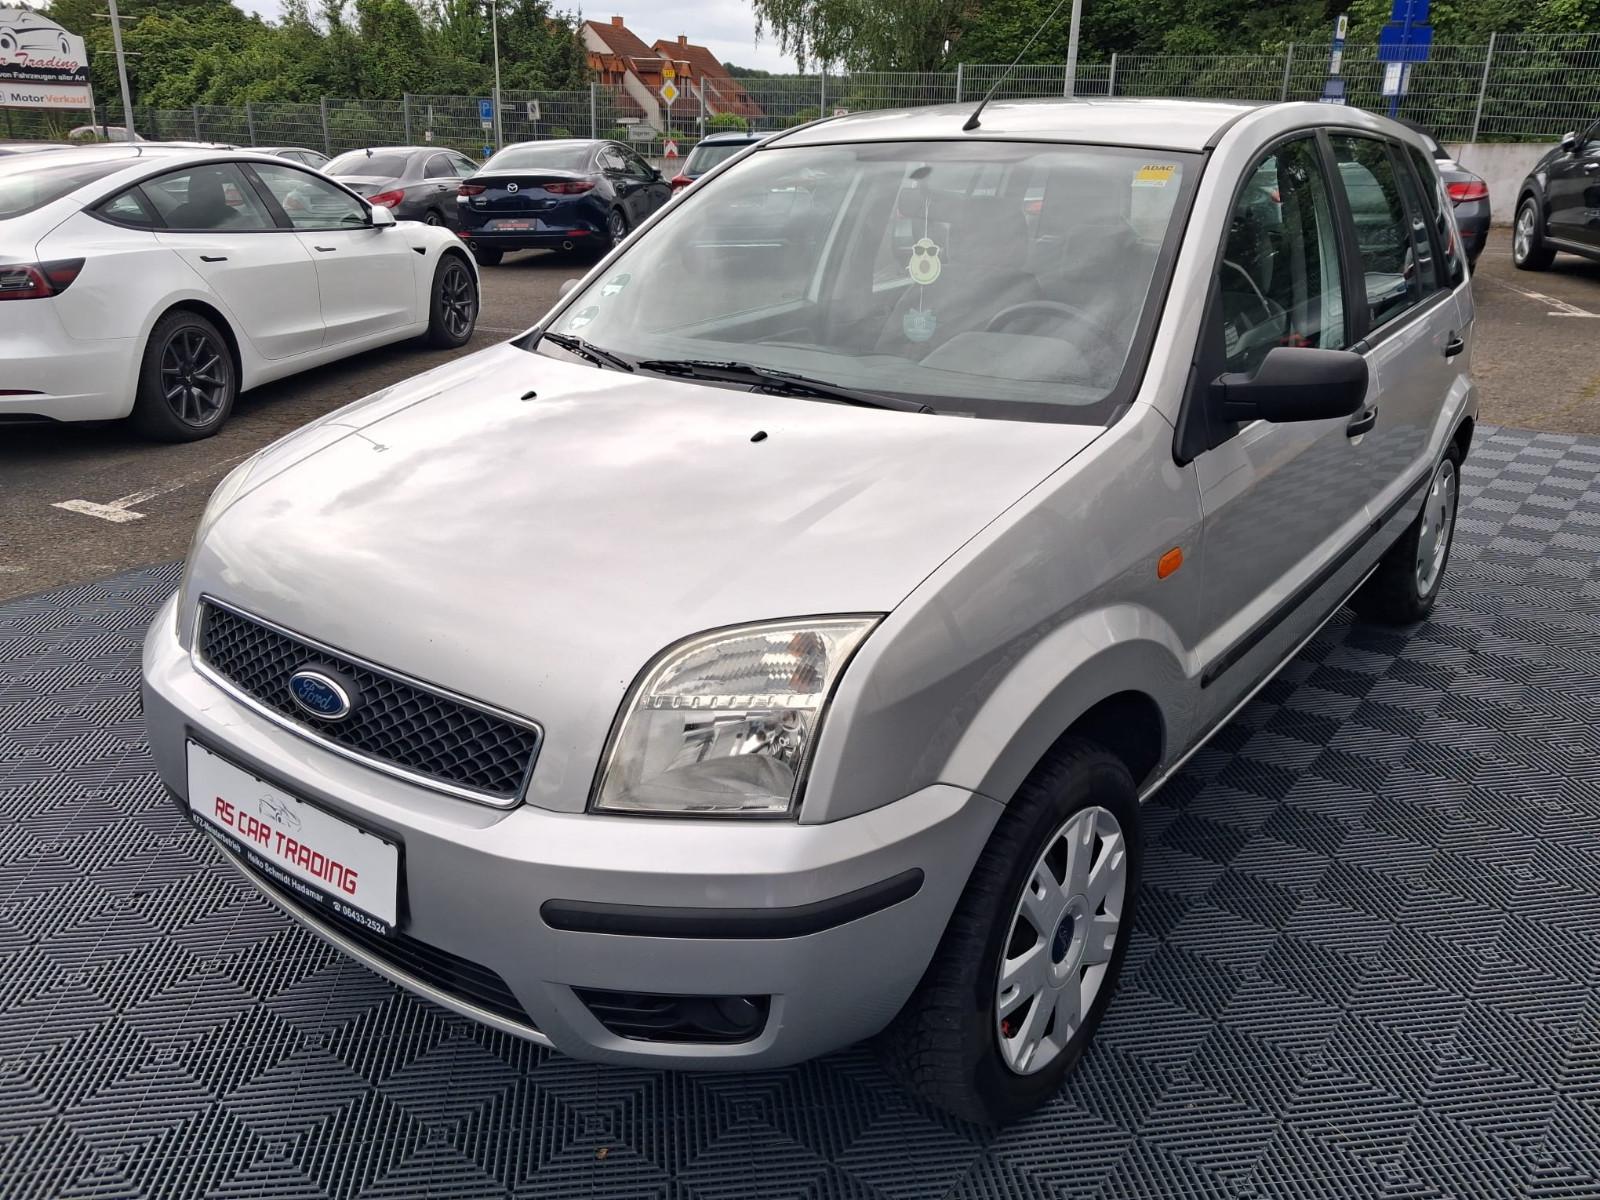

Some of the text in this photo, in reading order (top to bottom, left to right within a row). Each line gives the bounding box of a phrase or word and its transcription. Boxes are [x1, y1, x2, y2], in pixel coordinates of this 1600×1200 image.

[12, 72, 56, 80] Fahrzeugen
[15, 52, 79, 73] Trading
[299, 679, 333, 710] Ford
[215, 797, 358, 895] RS CAR TRADING
[247, 851, 264, 868] Heiko
[264, 863, 290, 886] Schmidt
[291, 879, 323, 902] Hadamar
[343, 905, 386, 935] 06433-2524
